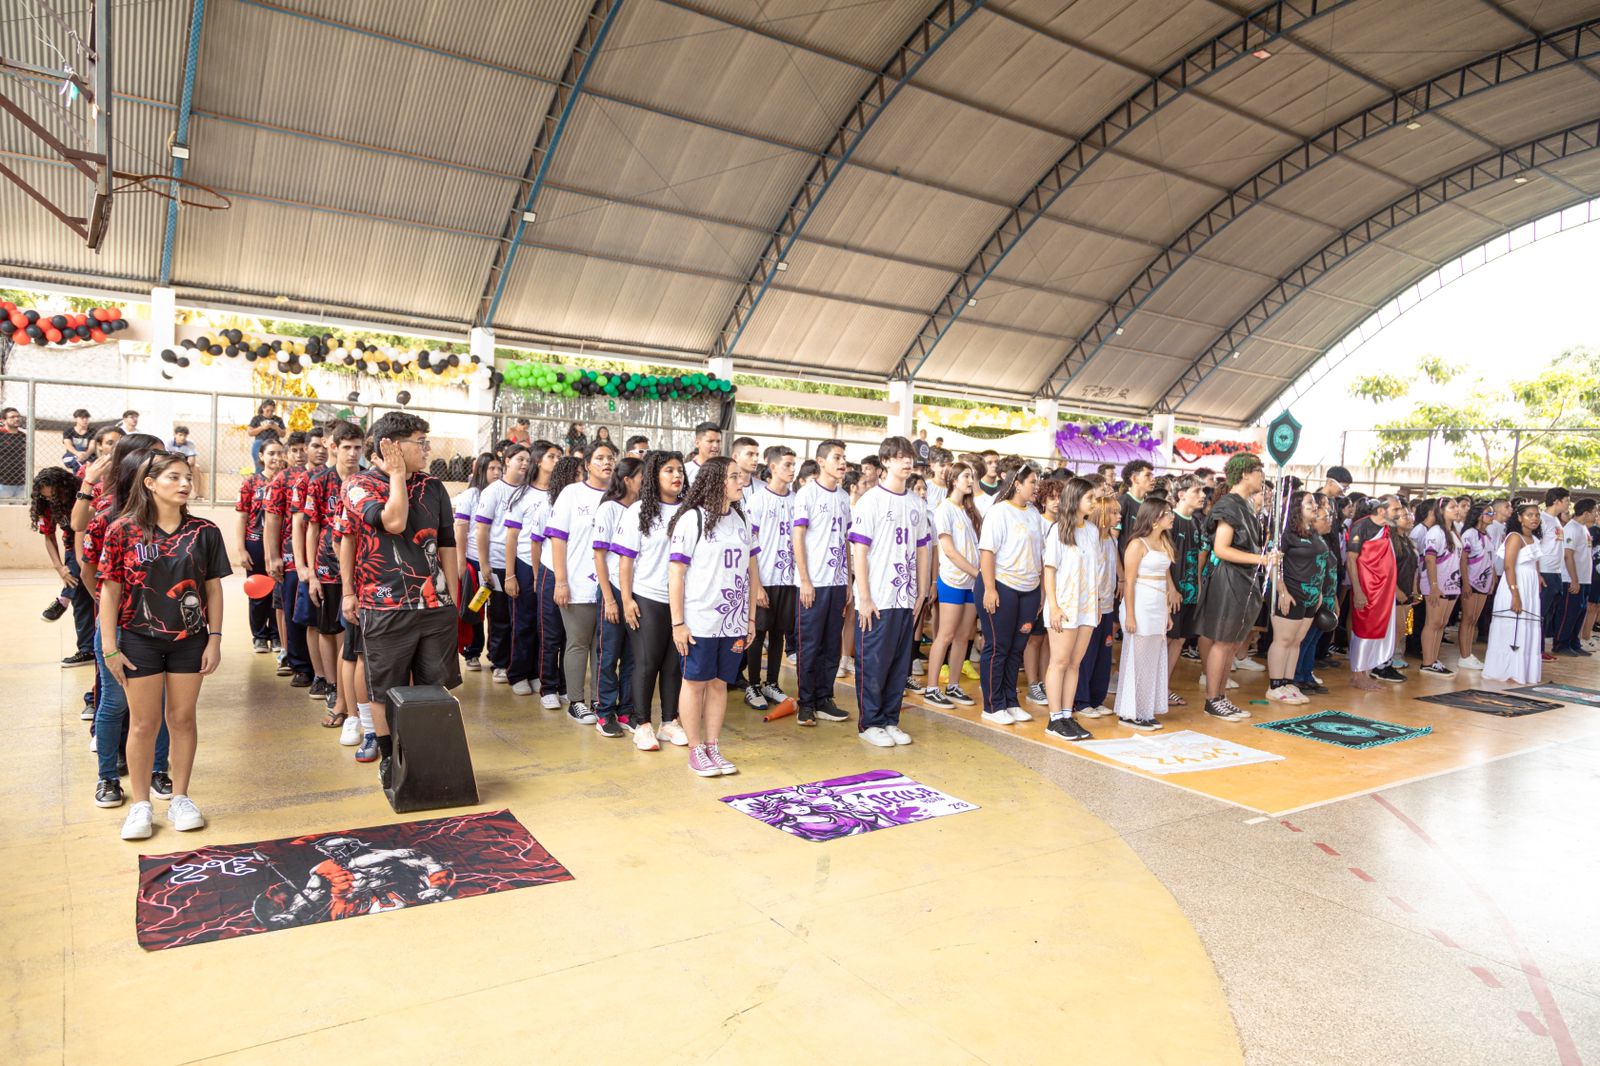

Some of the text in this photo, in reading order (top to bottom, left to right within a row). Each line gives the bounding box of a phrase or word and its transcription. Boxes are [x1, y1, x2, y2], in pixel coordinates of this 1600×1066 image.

[895, 526, 909, 545] 81
[724, 548, 742, 568] 07
[867, 787, 939, 806] DEUSA
